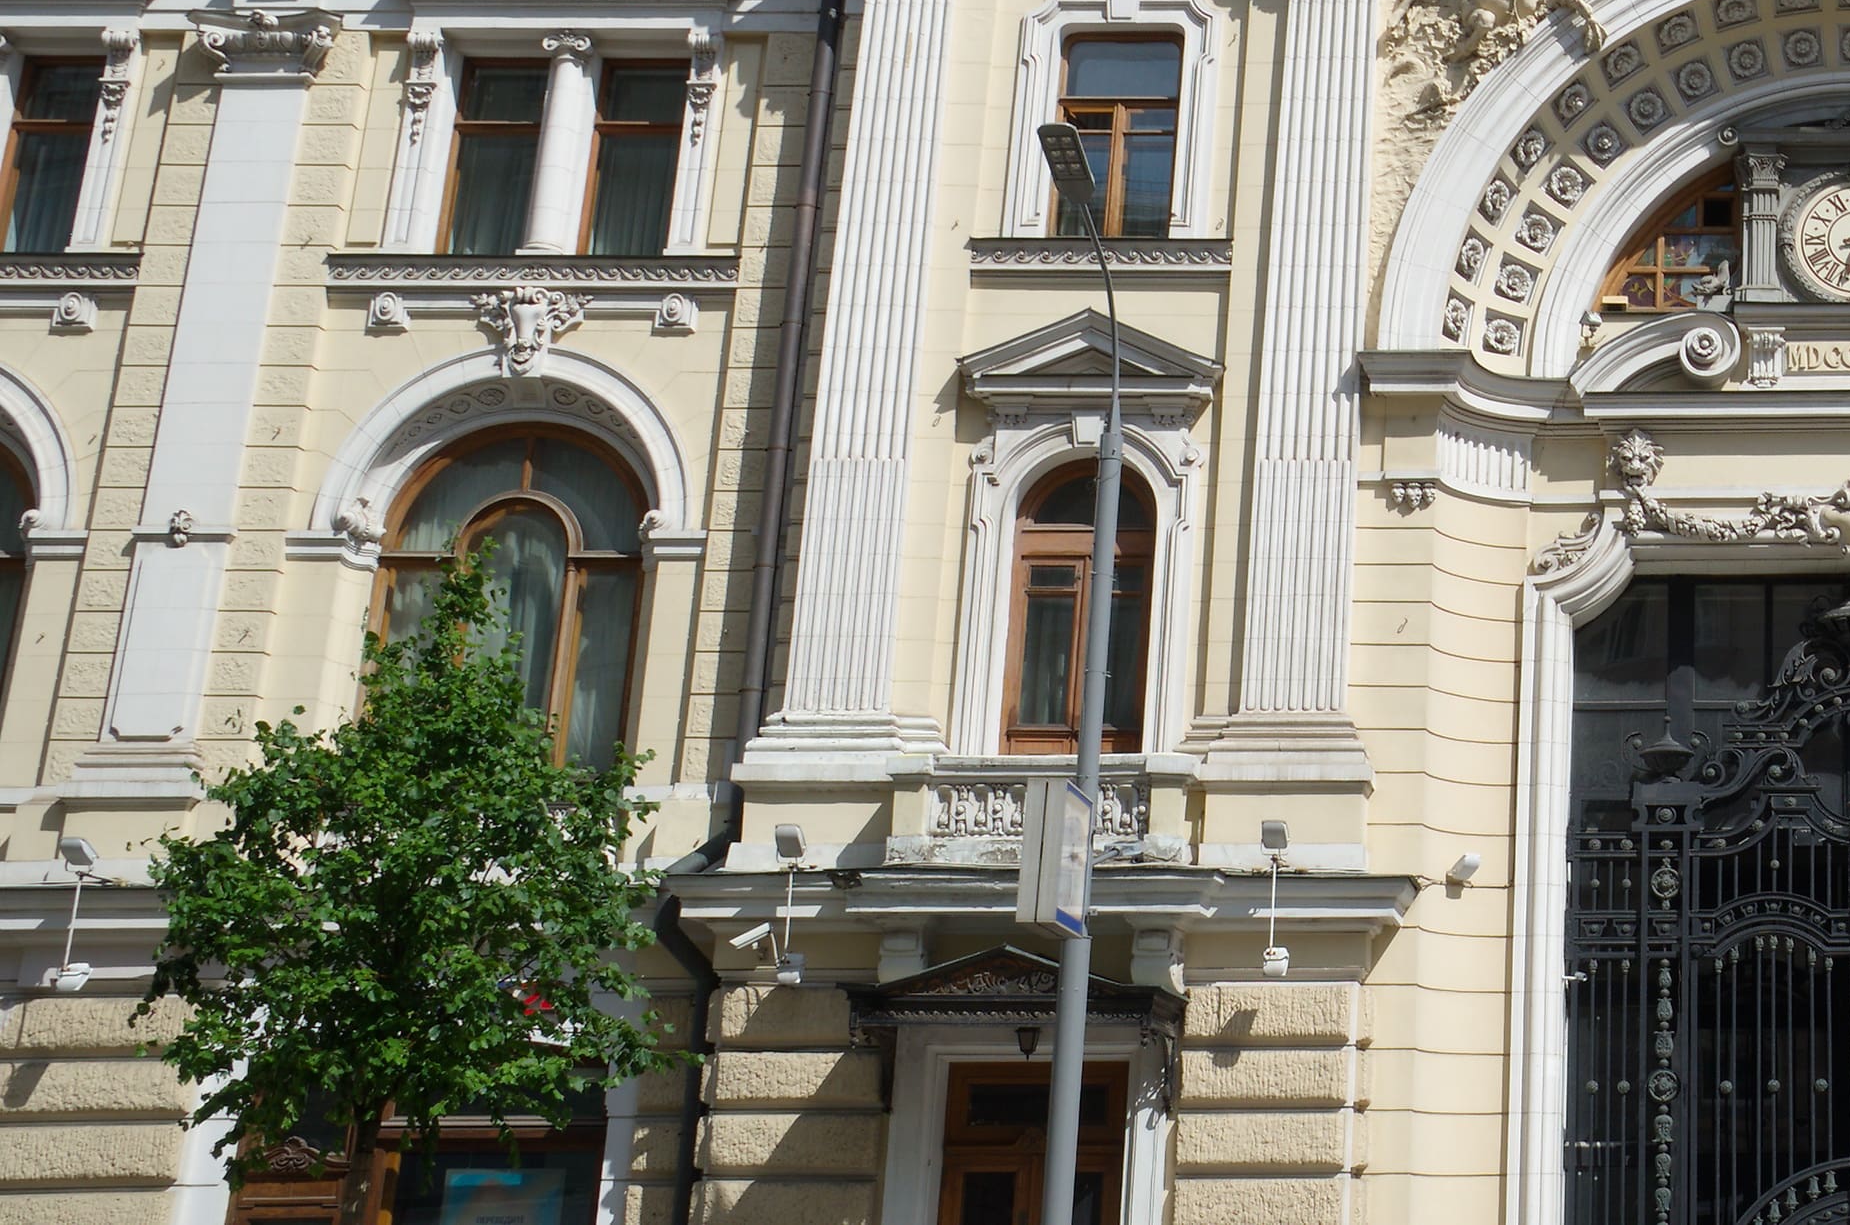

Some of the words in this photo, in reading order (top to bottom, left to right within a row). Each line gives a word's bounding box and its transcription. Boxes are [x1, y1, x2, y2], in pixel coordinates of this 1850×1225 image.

[1827, 194, 1848, 216] XI
[1810, 211, 1833, 228] X
[1804, 233, 1826, 245] IX
[1808, 248, 1832, 273] VIII
